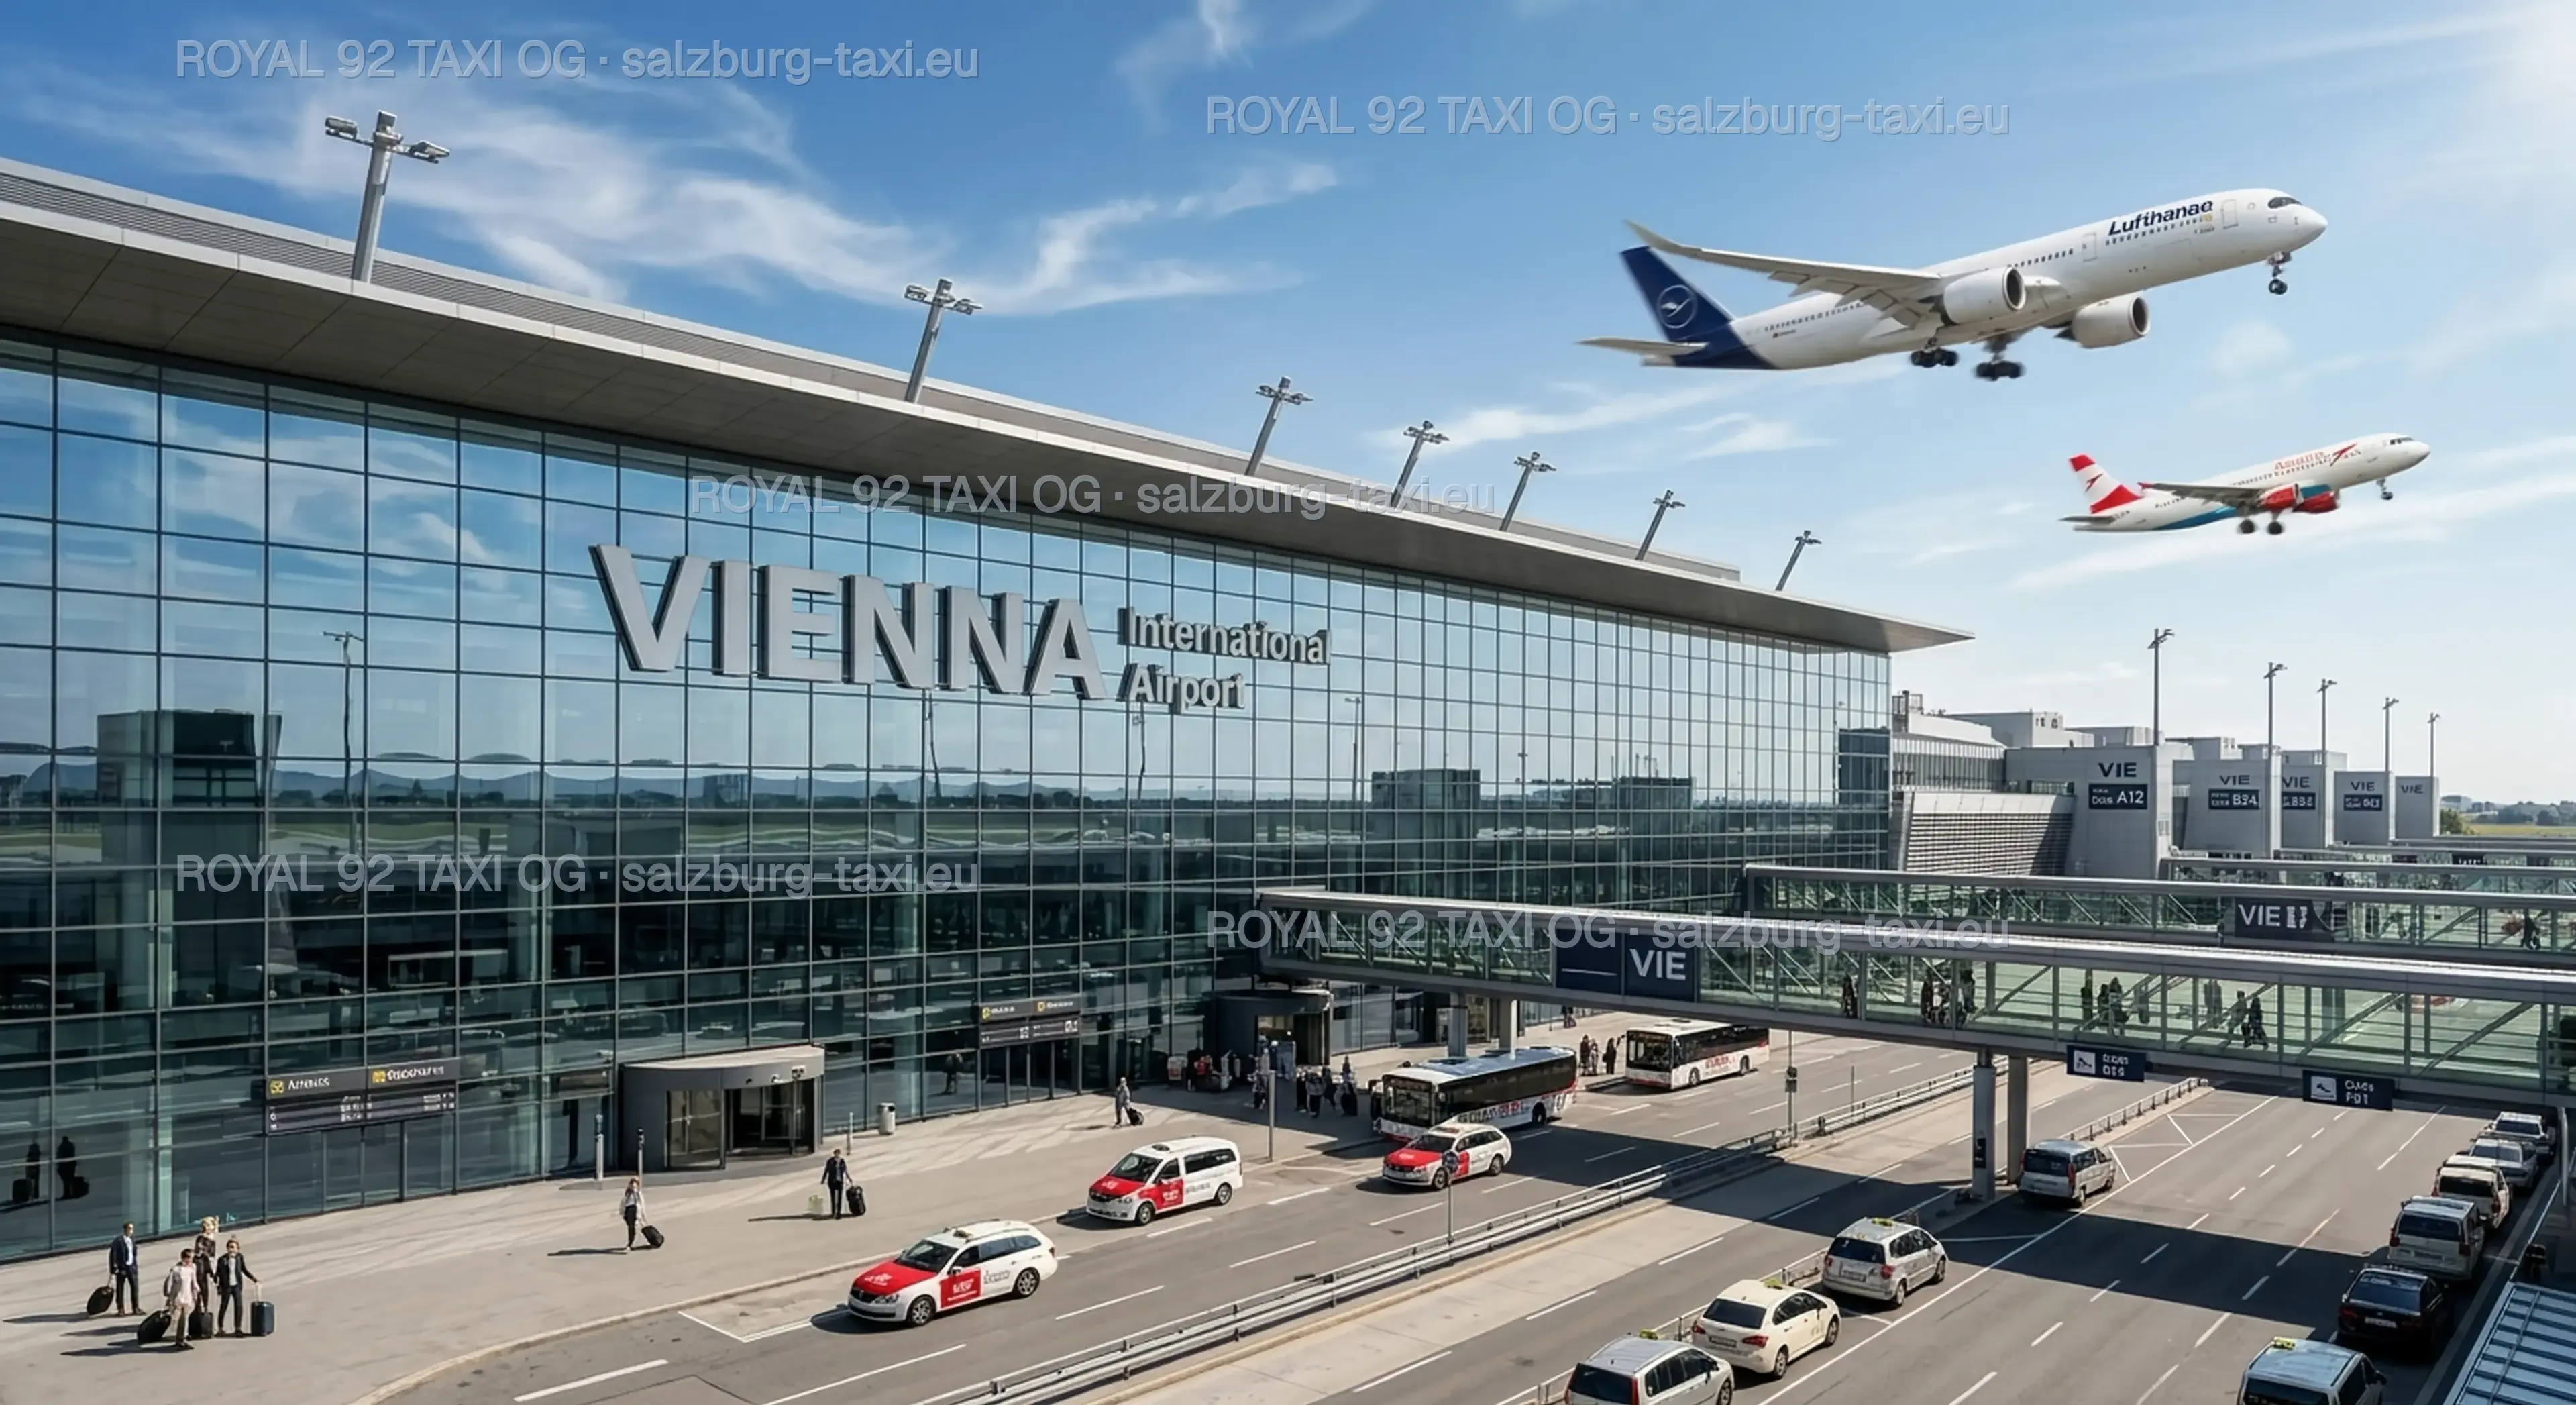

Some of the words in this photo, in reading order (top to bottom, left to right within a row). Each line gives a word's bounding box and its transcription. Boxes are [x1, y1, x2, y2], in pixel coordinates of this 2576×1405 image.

[588, 543, 1106, 700] VIENNA
[1119, 607, 1331, 665] International
[1118, 663, 1244, 714] Airport
[2098, 762, 2137, 778] VIE
[2219, 774, 2250, 786] VIE
[2282, 776, 2310, 788] VIE
[2350, 781, 2375, 792] VIE
[2117, 790, 2144, 804] A12
[2400, 784, 2424, 794] VIE
[2237, 904, 2281, 927] VIE
[1629, 948, 1686, 981] VIE
